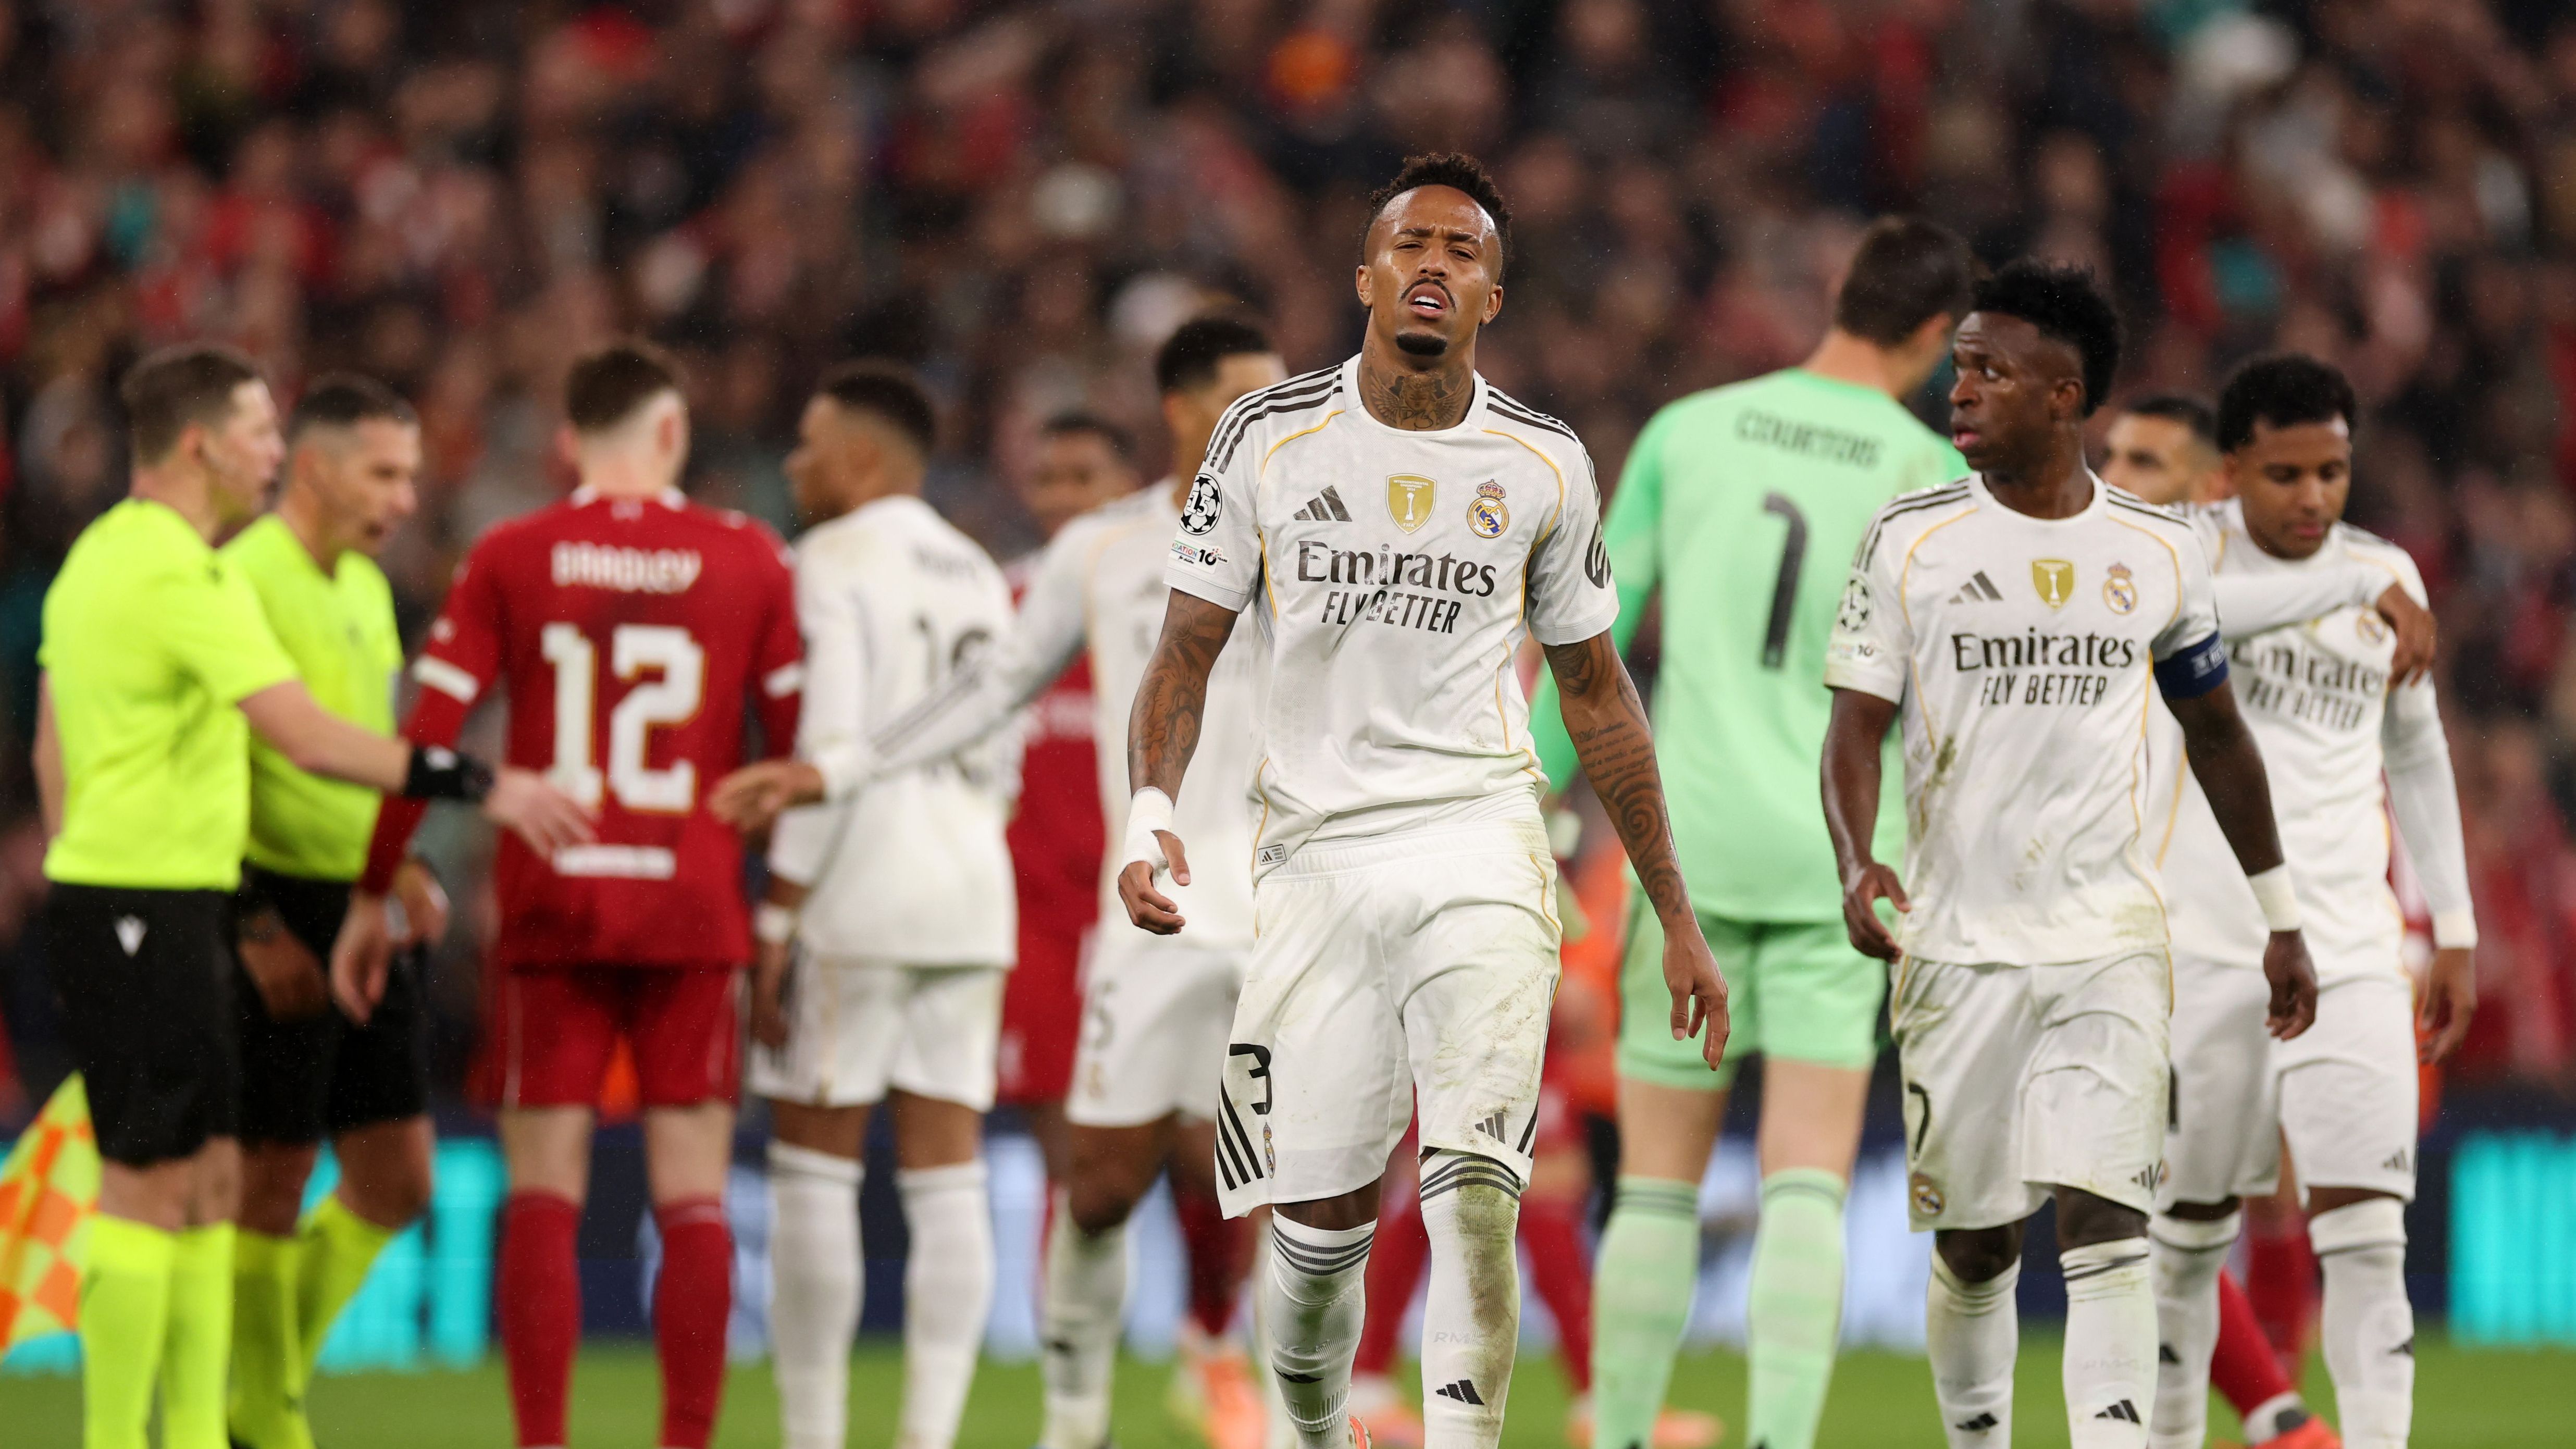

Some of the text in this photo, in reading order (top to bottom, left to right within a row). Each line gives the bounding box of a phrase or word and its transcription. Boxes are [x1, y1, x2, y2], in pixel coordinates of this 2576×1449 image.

[1186, 490, 1211, 517] 15
[1199, 549, 1217, 565] 10
[1298, 540, 1496, 597] Emirates
[1762, 490, 1810, 670] 1
[1321, 590, 1461, 634] FLY BETTER
[1951, 626, 2135, 672] Emirates
[1980, 674, 2107, 707] FLY BETTER
[542, 623, 708, 814] 12
[1229, 1043, 1272, 1115] 3
[1909, 1080, 1931, 1160] 7
